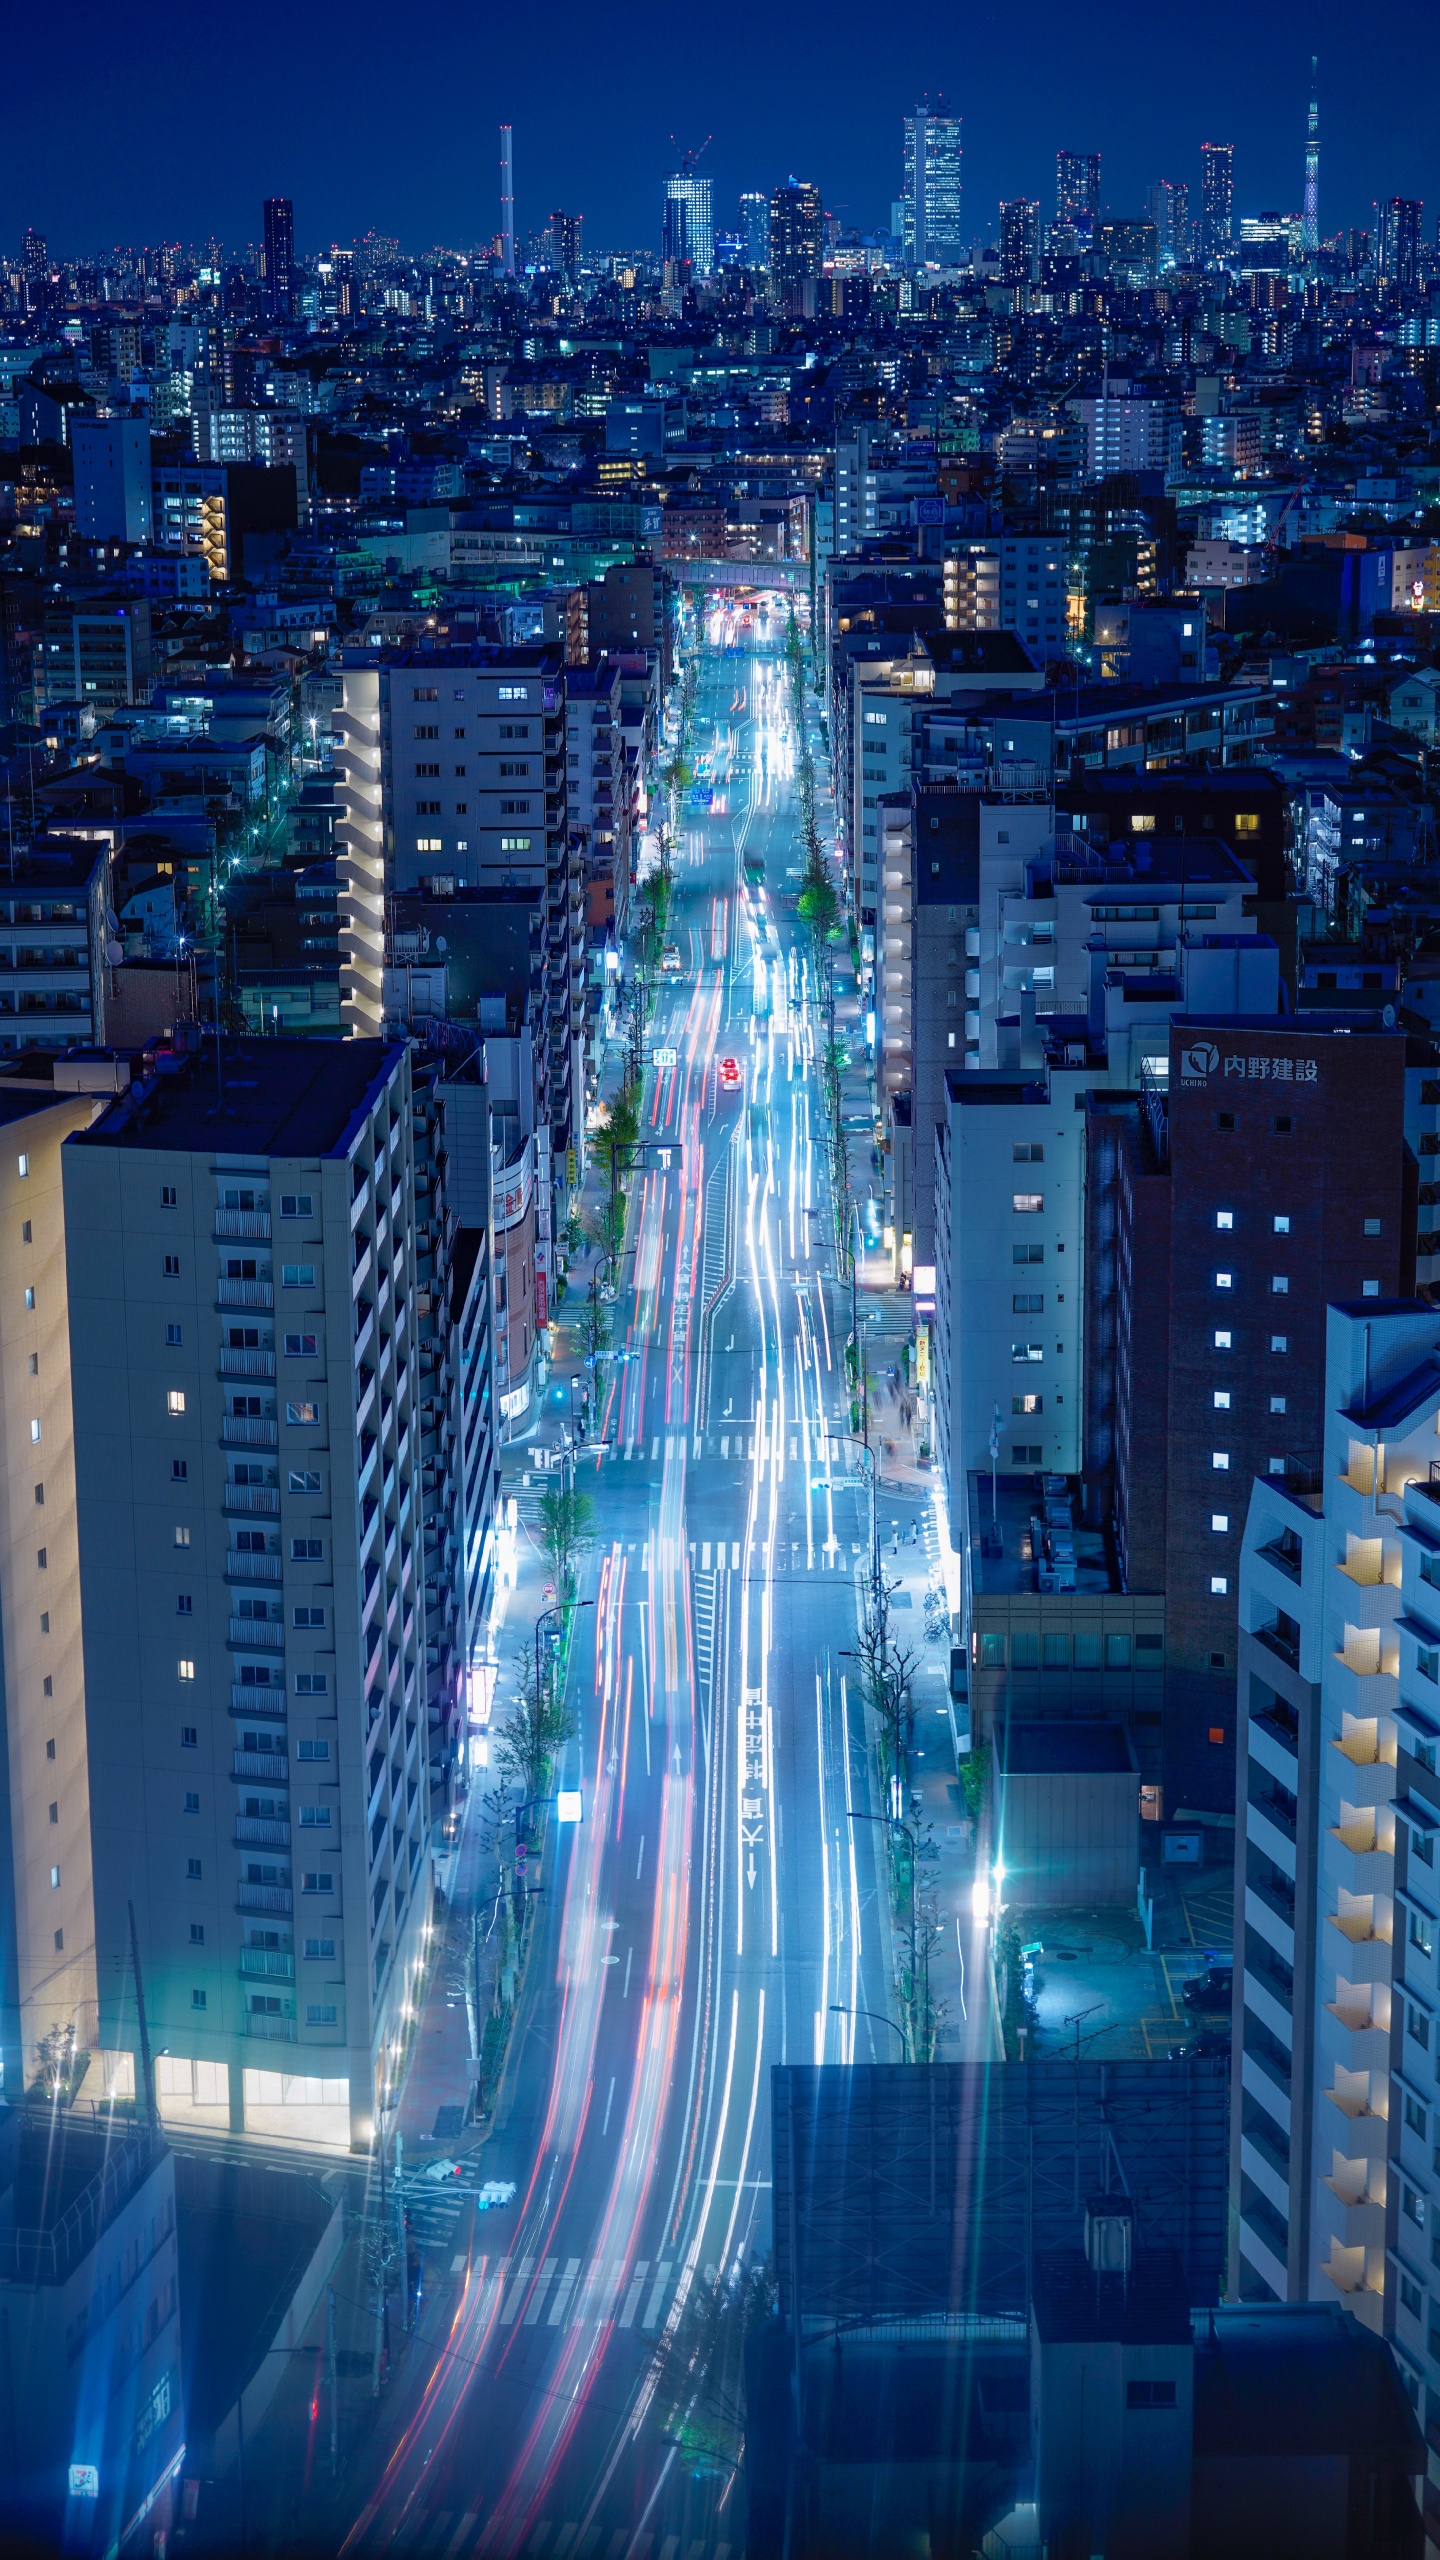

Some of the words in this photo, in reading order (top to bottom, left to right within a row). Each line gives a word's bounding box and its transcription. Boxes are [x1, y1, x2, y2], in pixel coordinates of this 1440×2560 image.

[1224, 1055, 1318, 1083] 内野建設
[1180, 1078, 1208, 1087] UCHINO
